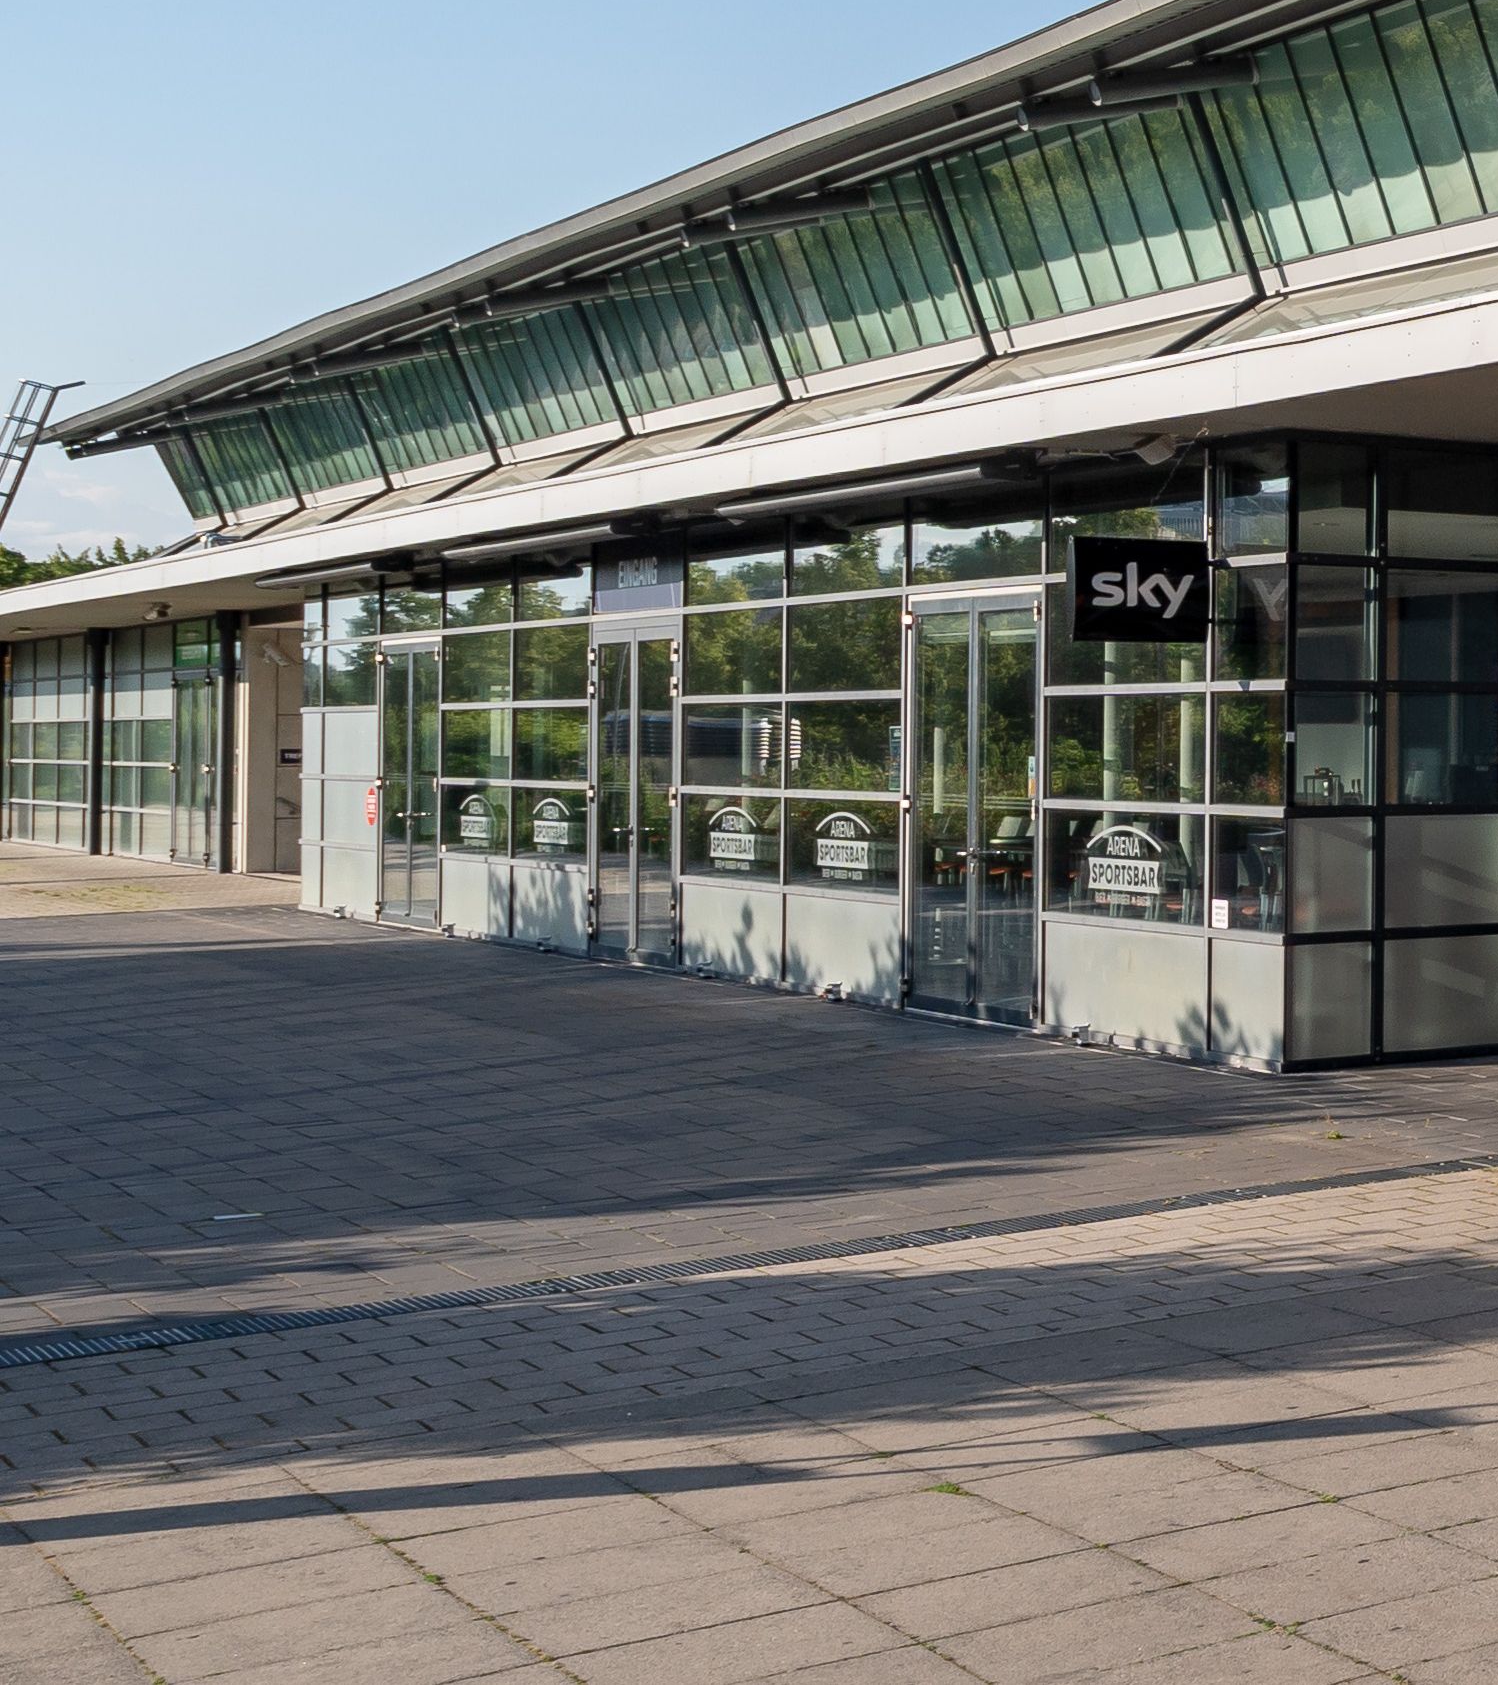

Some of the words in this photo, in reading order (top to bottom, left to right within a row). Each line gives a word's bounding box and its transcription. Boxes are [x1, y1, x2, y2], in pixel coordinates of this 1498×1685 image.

[1091, 561, 1195, 619] sky
[830, 820, 856, 838] ARENA
[711, 836, 753, 856] SPORTSBAR
[819, 843, 865, 865] SPORTSBAR
[1106, 836, 1141, 857] ARENA
[1091, 863, 1156, 888] SPORTSBAR
